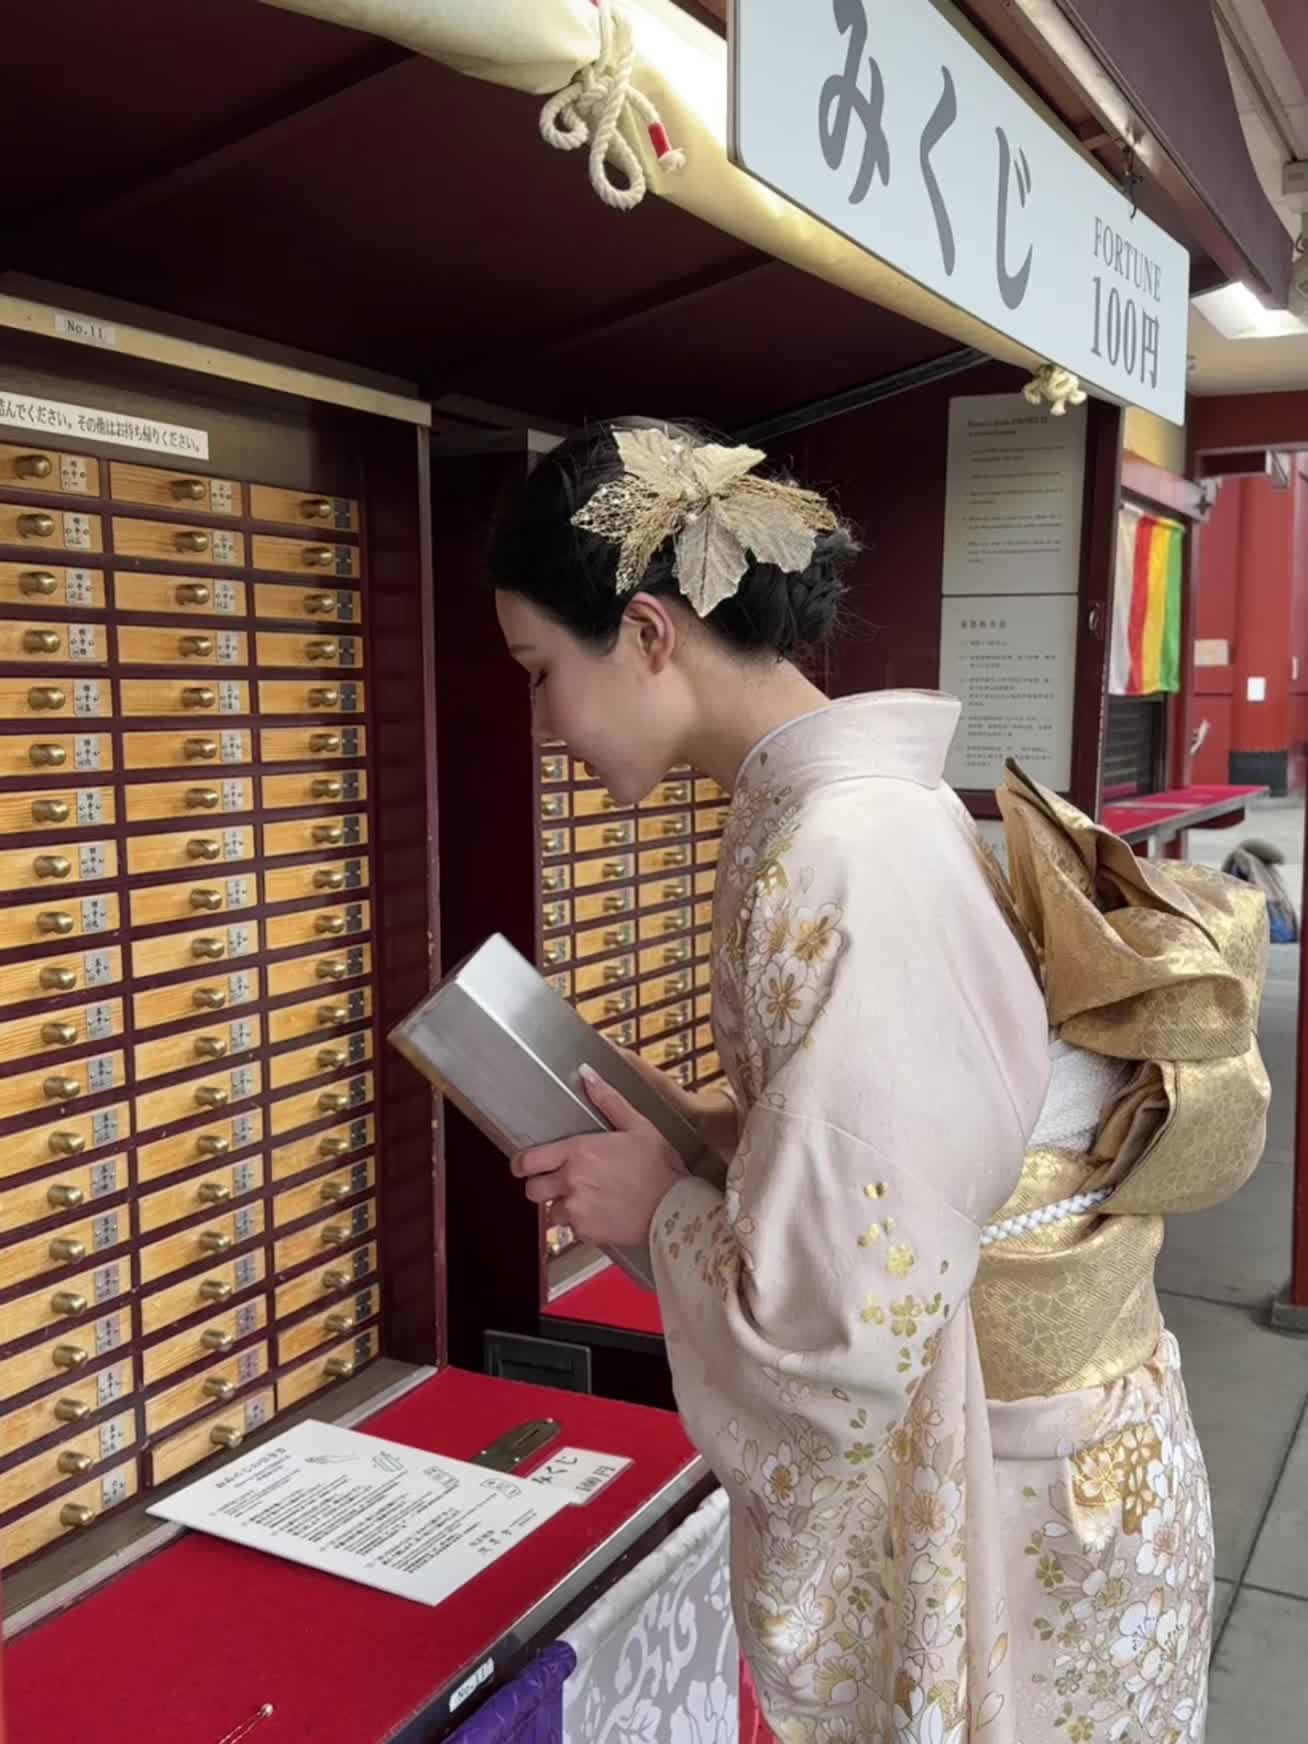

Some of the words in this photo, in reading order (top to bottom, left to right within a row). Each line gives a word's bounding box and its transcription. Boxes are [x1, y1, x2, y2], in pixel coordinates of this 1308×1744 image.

[818, 0, 1033, 310] みくじ
[1093, 215, 1162, 303] FORTUNE
[67, 319, 105, 340] No.11
[1090, 275, 1161, 390] 100円
